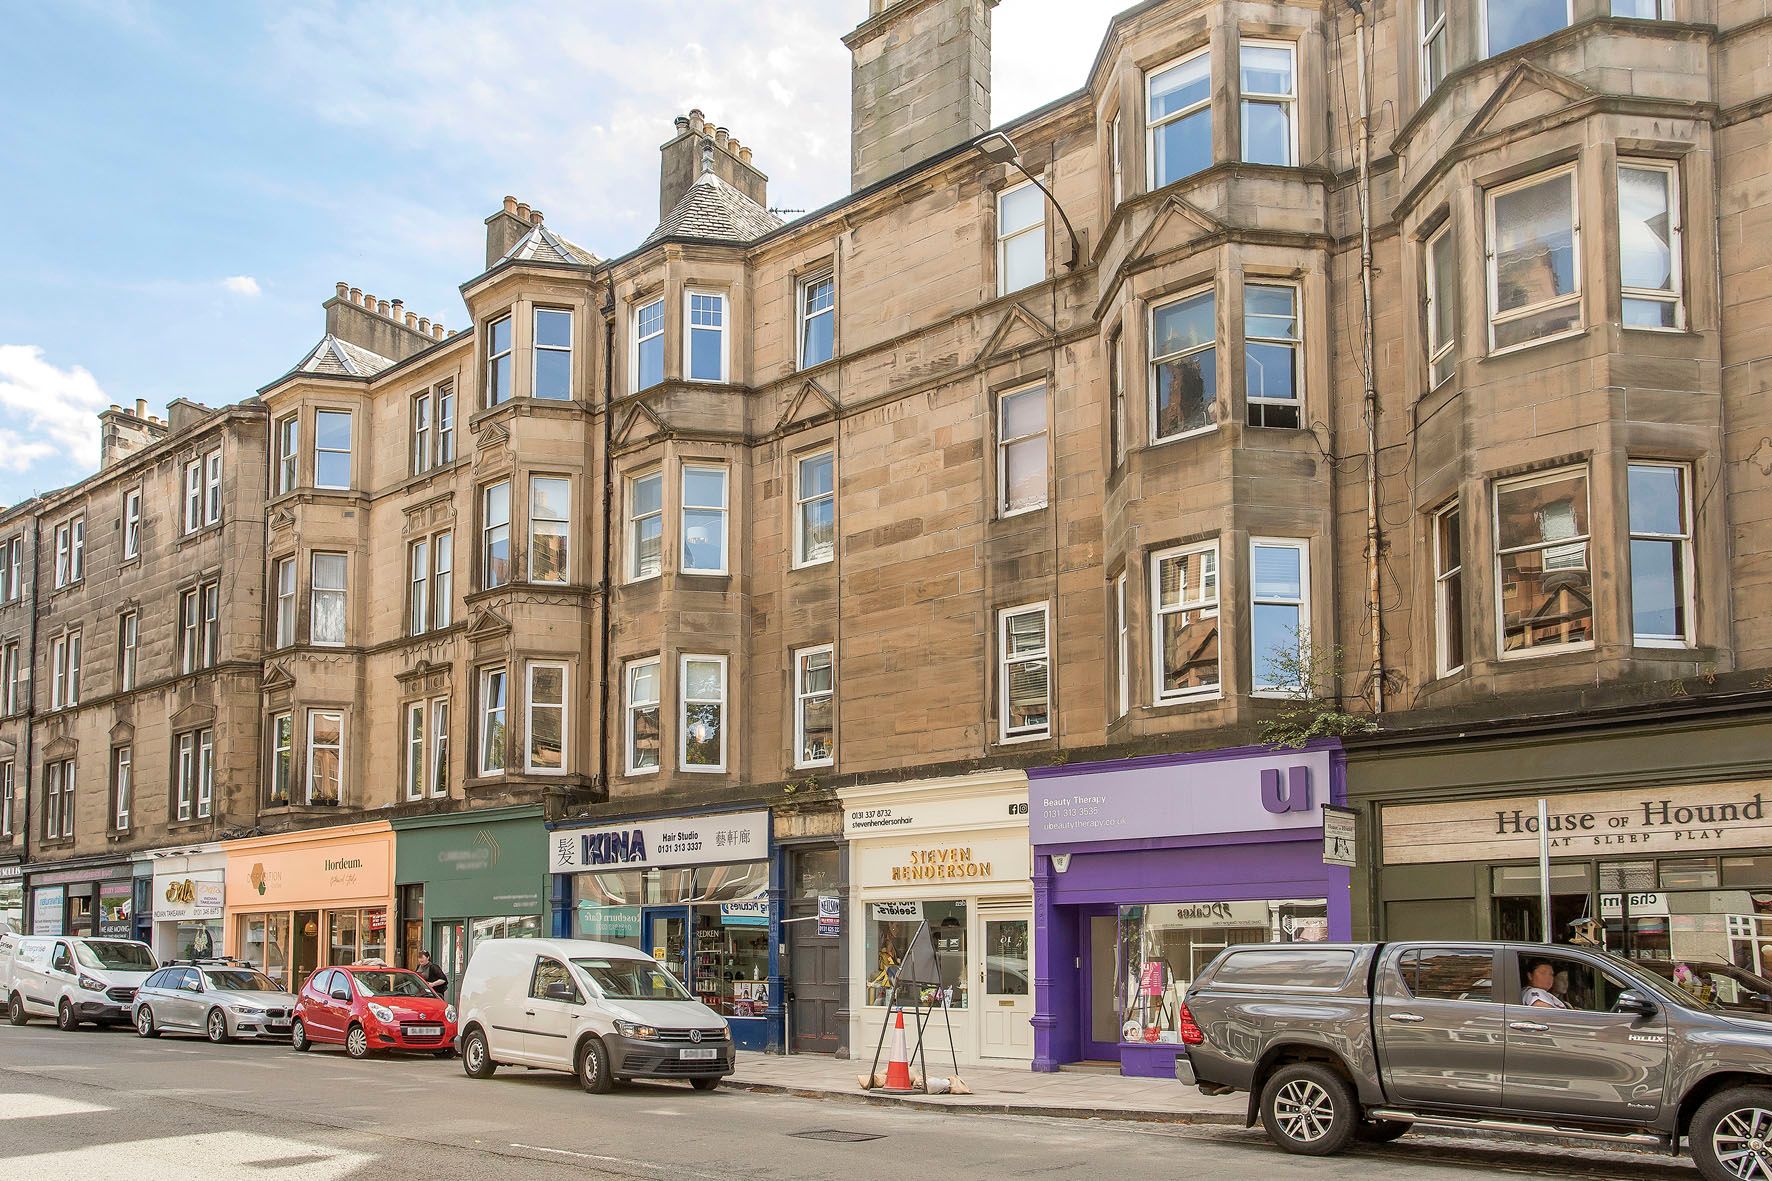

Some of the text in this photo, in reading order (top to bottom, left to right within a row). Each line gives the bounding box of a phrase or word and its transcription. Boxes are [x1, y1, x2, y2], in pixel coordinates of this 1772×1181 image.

[1261, 766, 1309, 814] u
[1043, 796, 1106, 807] Beauty Therapy
[851, 809, 892, 820] 0131 337 8732
[1043, 807, 1098, 819] 0131 313 3535
[1495, 793, 1764, 834] House OF Hound
[852, 817, 913, 829] stevenhendersonhair
[662, 830, 699, 843] Hair Studio
[1594, 833, 1651, 845] SLEEP
[1675, 829, 1724, 841] PLAY
[657, 841, 702, 854] 0131 313 3337
[910, 847, 971, 865] STEVEN
[324, 857, 363, 871] Hordeum.
[891, 861, 991, 880] HENDERSON
[696, 929, 720, 938] REDKEN
[1628, 1034, 1665, 1042] HILUX
